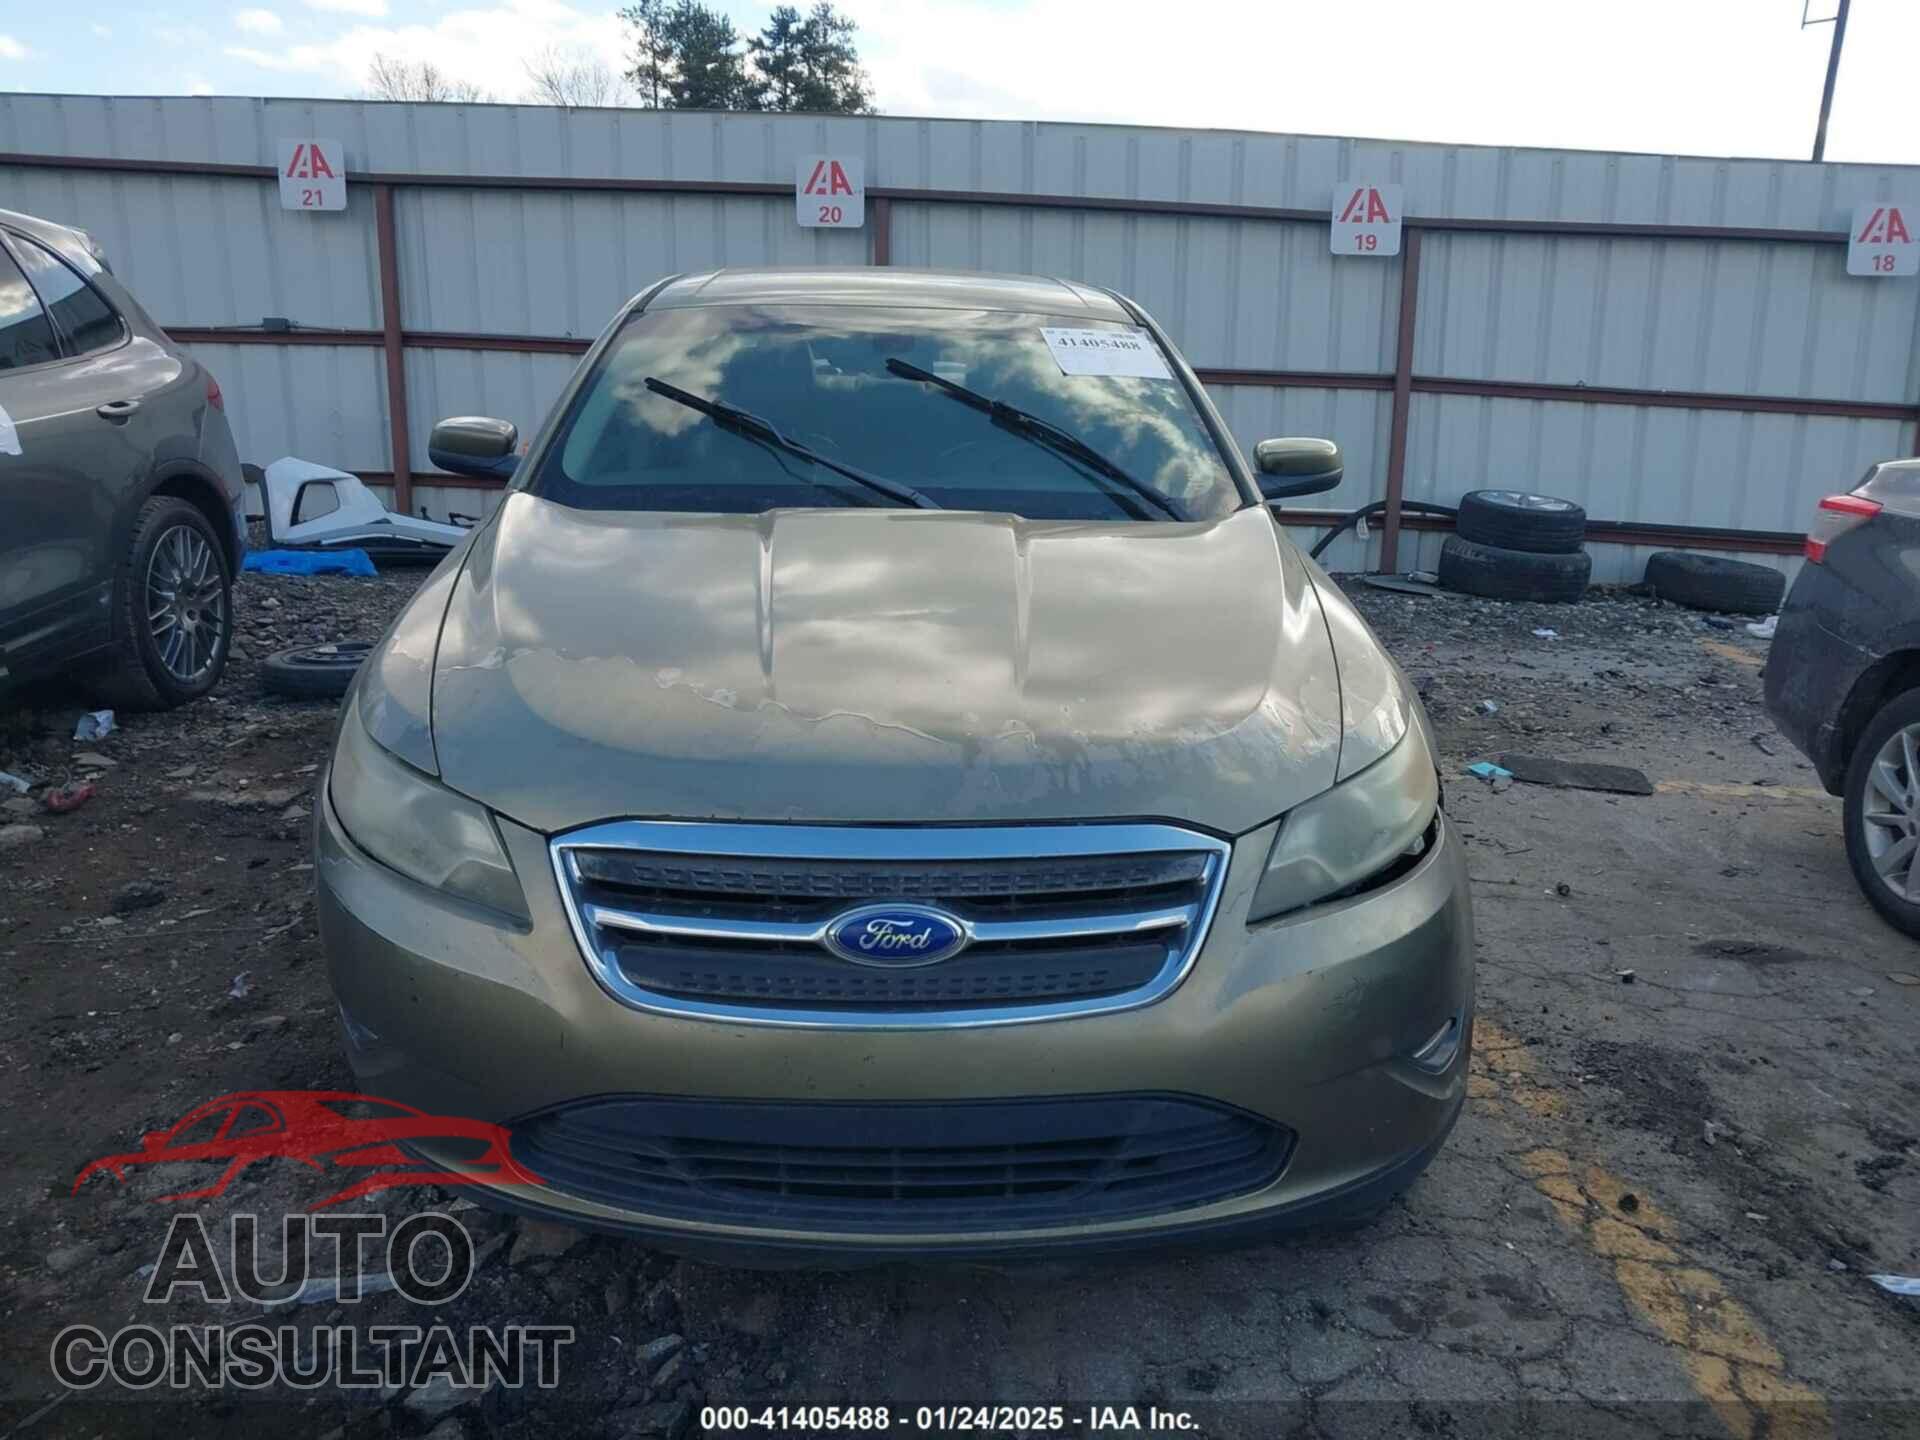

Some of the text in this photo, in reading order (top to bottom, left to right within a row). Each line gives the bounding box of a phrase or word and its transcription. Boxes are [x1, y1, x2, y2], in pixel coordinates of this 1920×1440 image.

[302, 189, 322, 206] 21
[819, 206, 842, 223] 20
[1354, 234, 1377, 251] 19
[1872, 254, 1895, 271] 18
[859, 918, 932, 949] Ford
